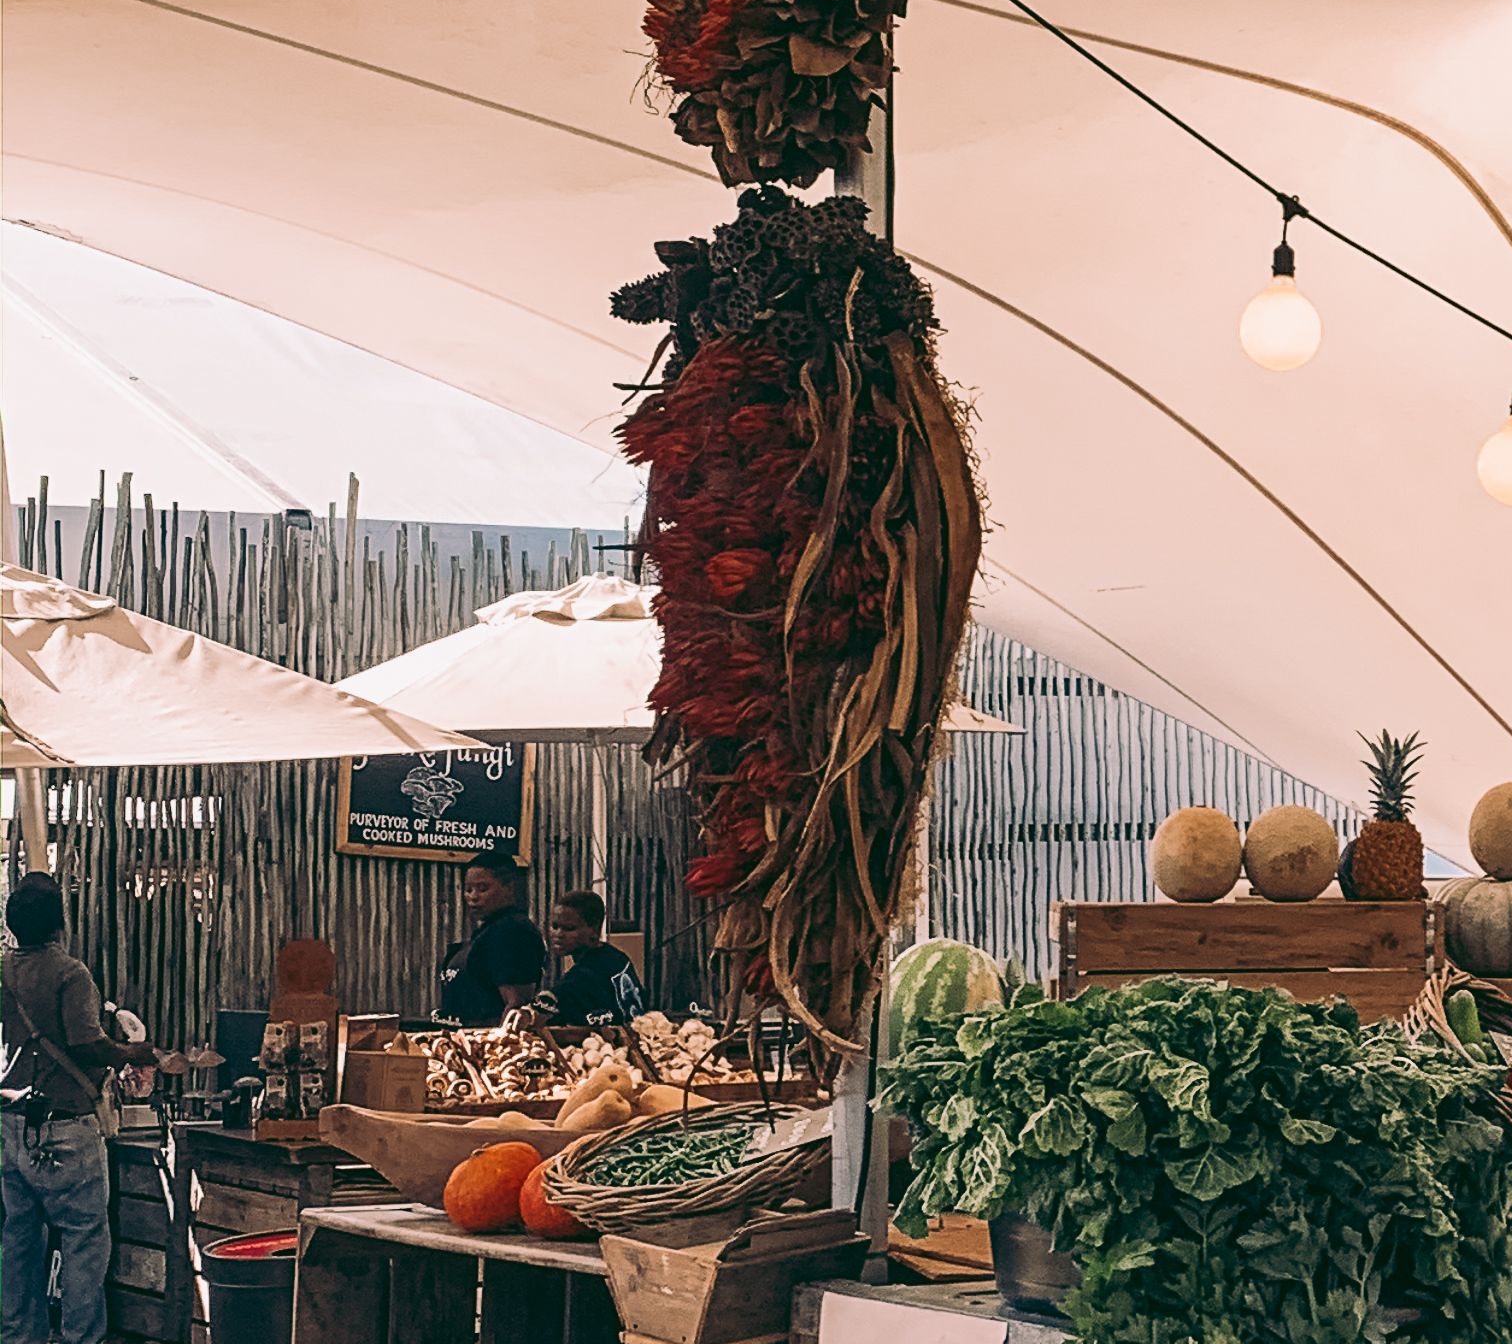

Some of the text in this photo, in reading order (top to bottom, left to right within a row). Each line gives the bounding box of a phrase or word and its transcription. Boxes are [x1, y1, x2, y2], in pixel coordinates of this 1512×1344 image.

[349, 812, 517, 839] PURVEYOR OF FRESH AND
[362, 828, 495, 851] COOKED MUSHROOMS
